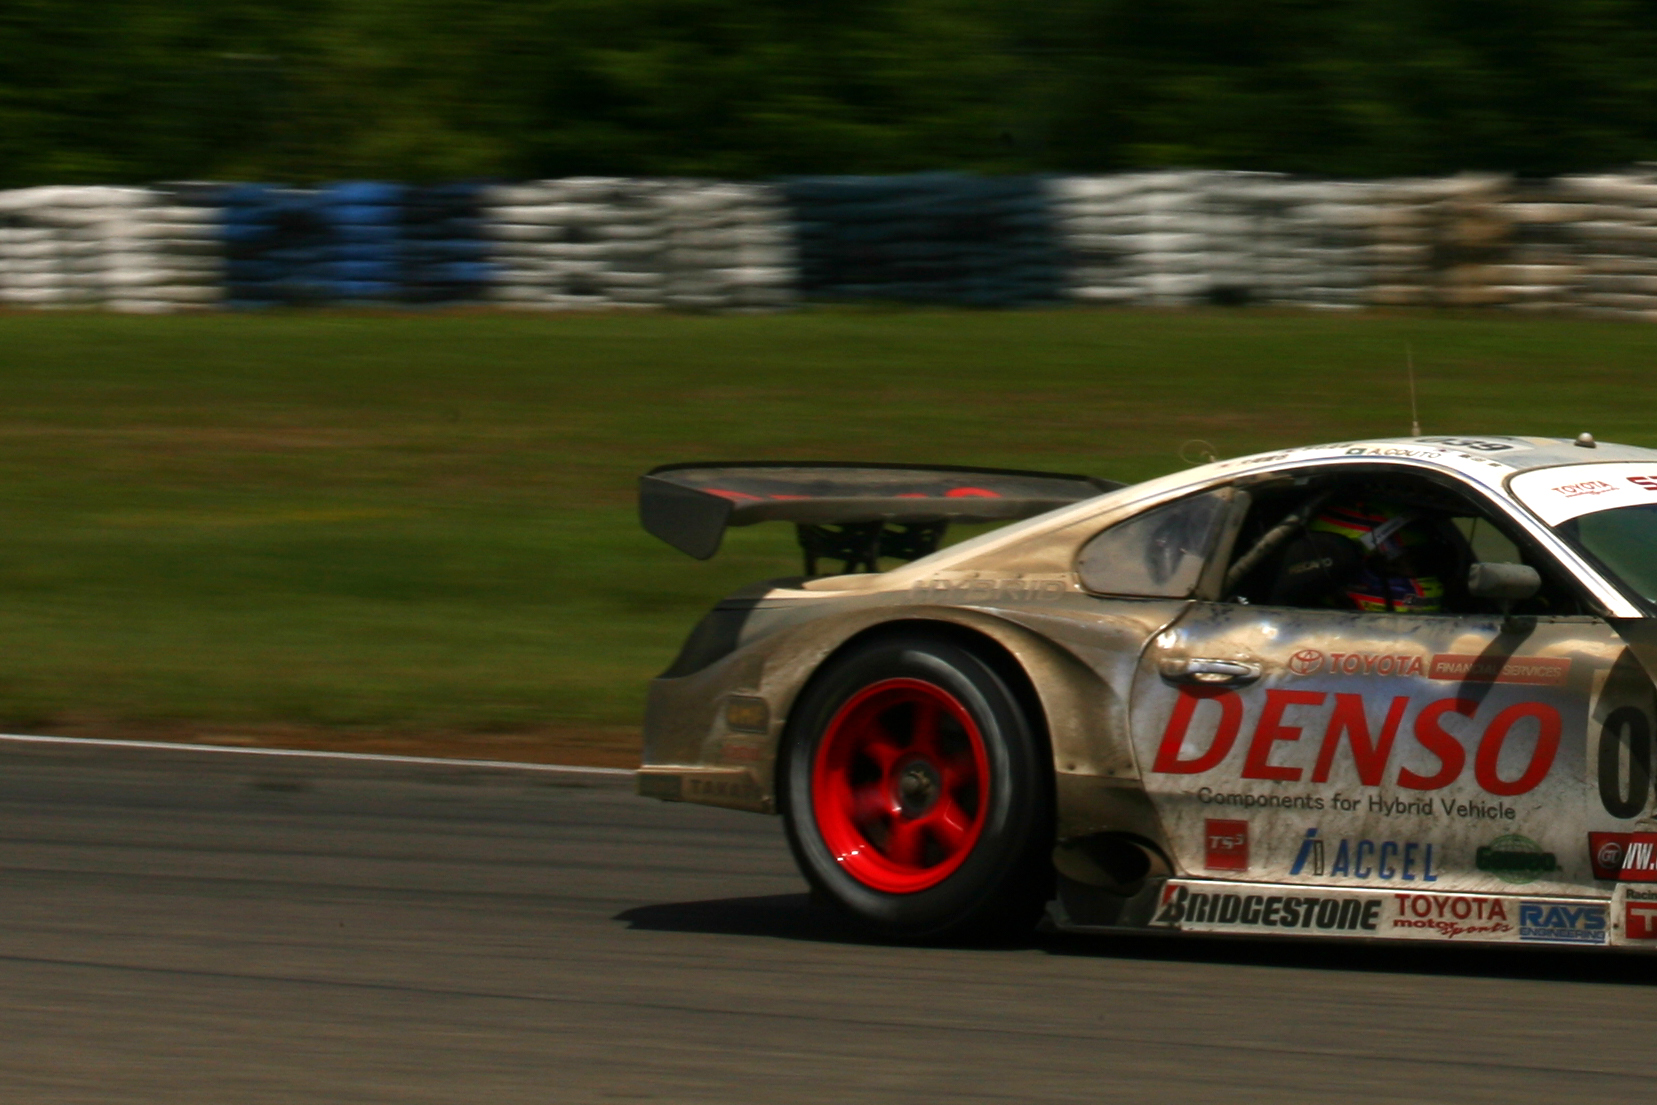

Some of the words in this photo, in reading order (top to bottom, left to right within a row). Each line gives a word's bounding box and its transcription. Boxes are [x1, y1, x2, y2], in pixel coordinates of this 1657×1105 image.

[1551, 480, 1613, 495] TOYOTA
[1330, 653, 1424, 677] TOYOTA
[1435, 662, 1499, 676] FINANCIAL
[1502, 665, 1563, 678] SERVICES
[1151, 685, 1562, 796] DENSO
[1199, 786, 1325, 810] Components
[1331, 792, 1362, 811] for
[1369, 791, 1434, 817] Hybrid
[1440, 799, 1517, 820] Vehicle
[1331, 837, 1439, 882] ACCEL
[1155, 884, 1382, 931] BRIDGESTONE
[1394, 893, 1508, 921] TOYOTA
[1519, 904, 1606, 930] RAYS
[1393, 918, 1458, 929] motor
[1519, 928, 1606, 939] ENGINEERING
